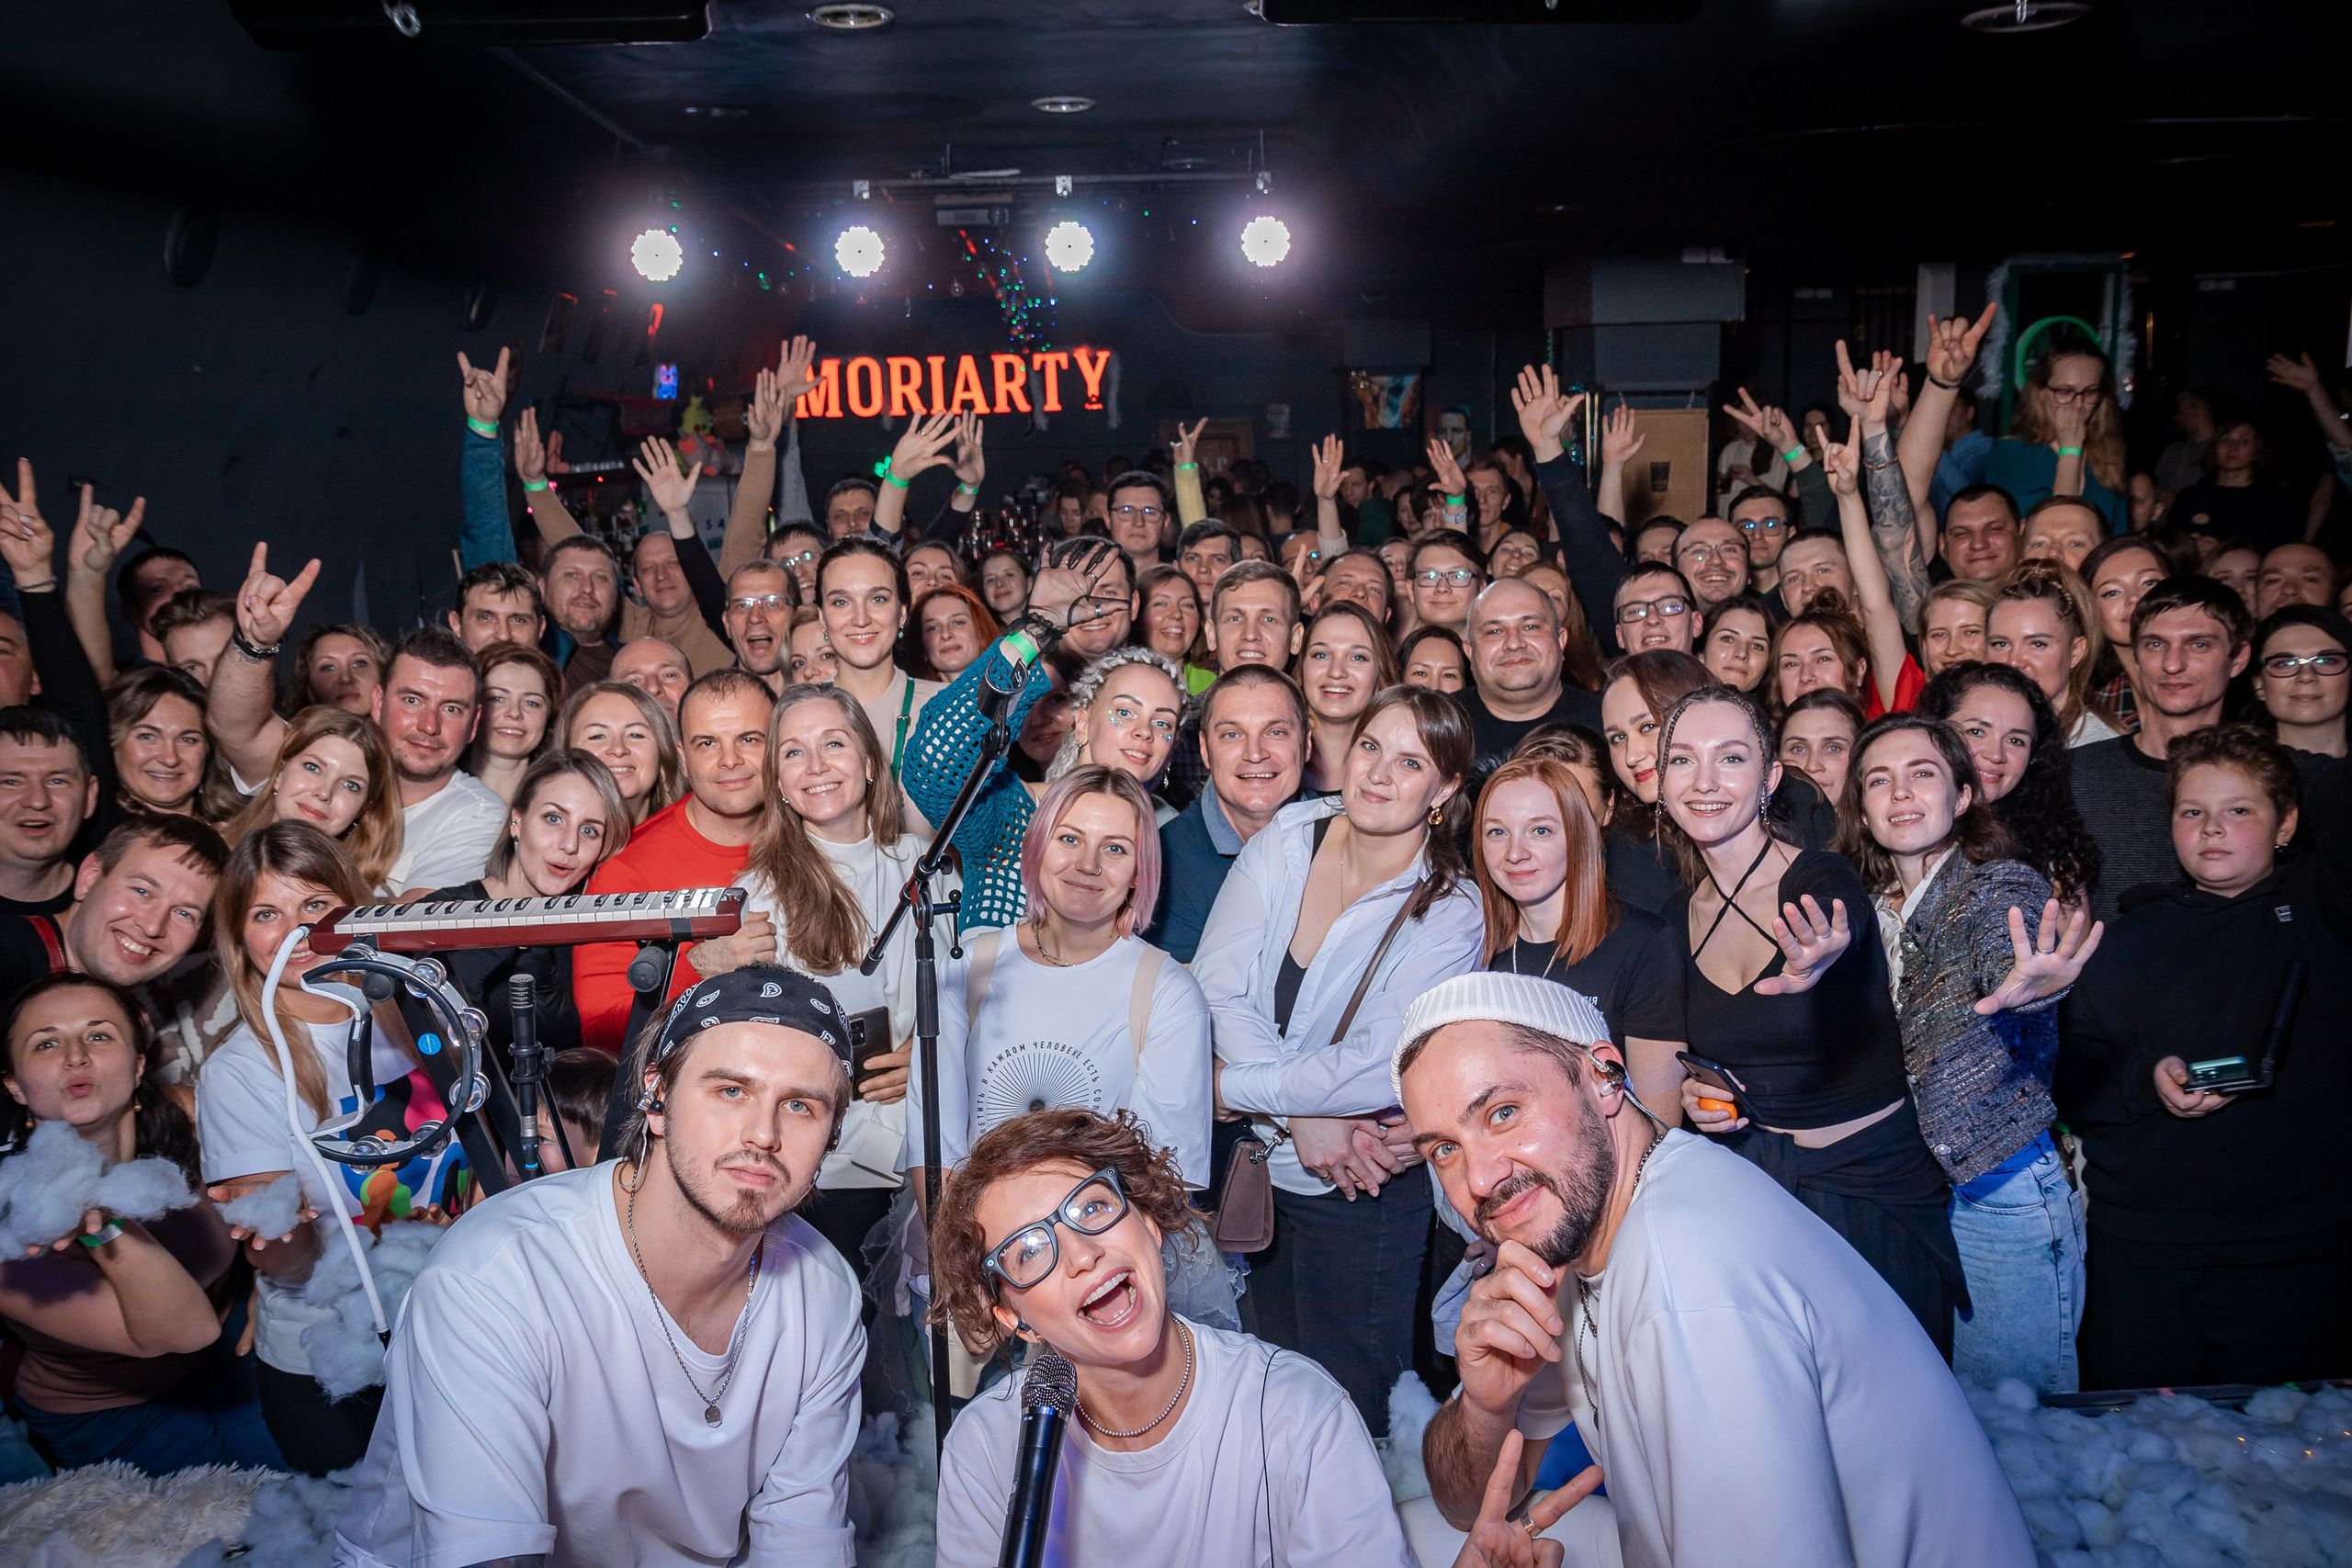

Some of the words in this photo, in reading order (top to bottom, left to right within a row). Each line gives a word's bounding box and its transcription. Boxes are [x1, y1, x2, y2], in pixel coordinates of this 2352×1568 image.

[794, 349, 1111, 419] MORIARTY
[986, 1043, 1026, 1074] КАЖДОМ
[1033, 1041, 1083, 1060] ЧЕЛОВЕКЕ
[1082, 1058, 1100, 1082] ЕСТЬ
[1092, 1089, 1102, 1111] СОЛ
[977, 1089, 987, 1134] ВЕТИТЬ.
